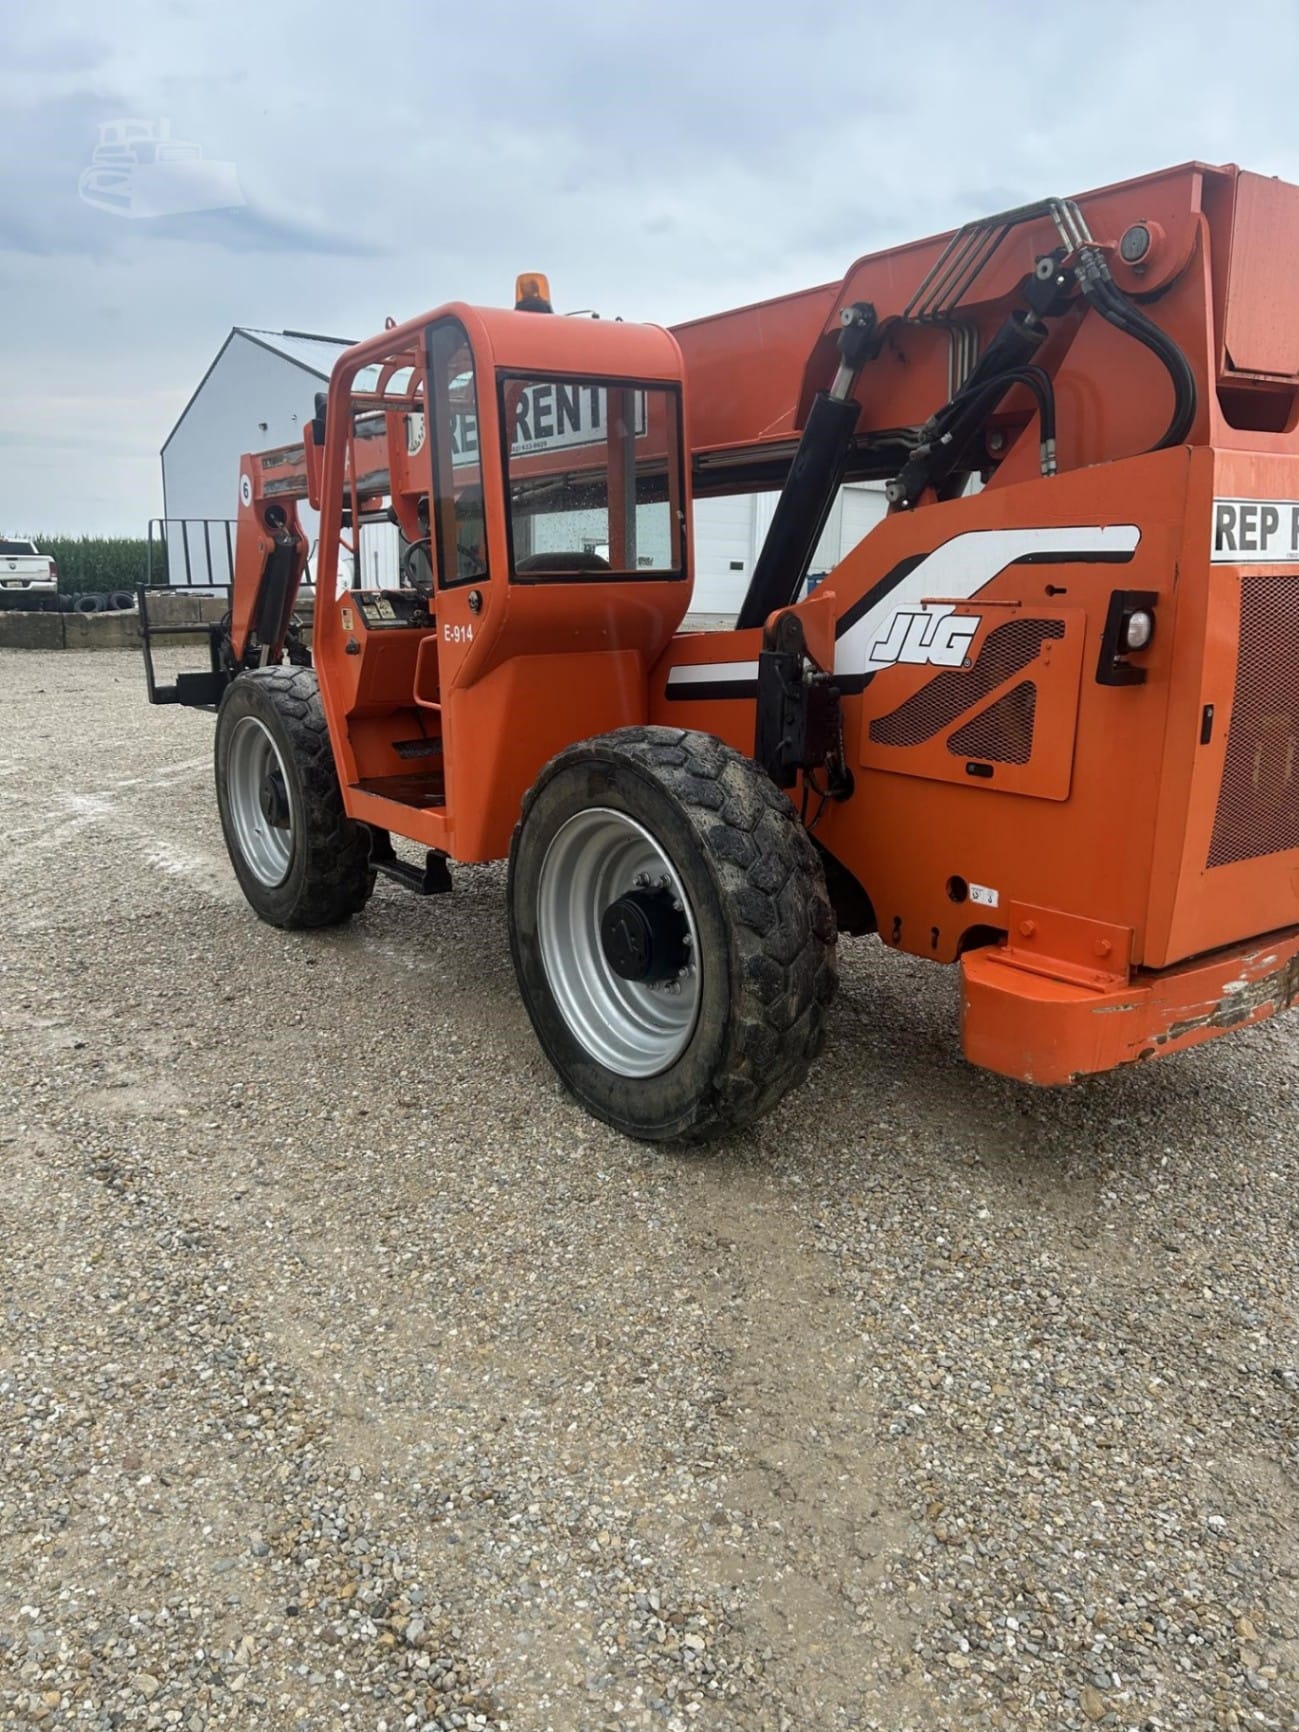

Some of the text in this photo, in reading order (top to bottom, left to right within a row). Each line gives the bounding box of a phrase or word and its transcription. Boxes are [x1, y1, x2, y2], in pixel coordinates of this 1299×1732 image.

[242, 481, 250, 499] 6
[1215, 505, 1279, 551] REP
[443, 623, 474, 643] E-914
[869, 612, 982, 668] JLG
